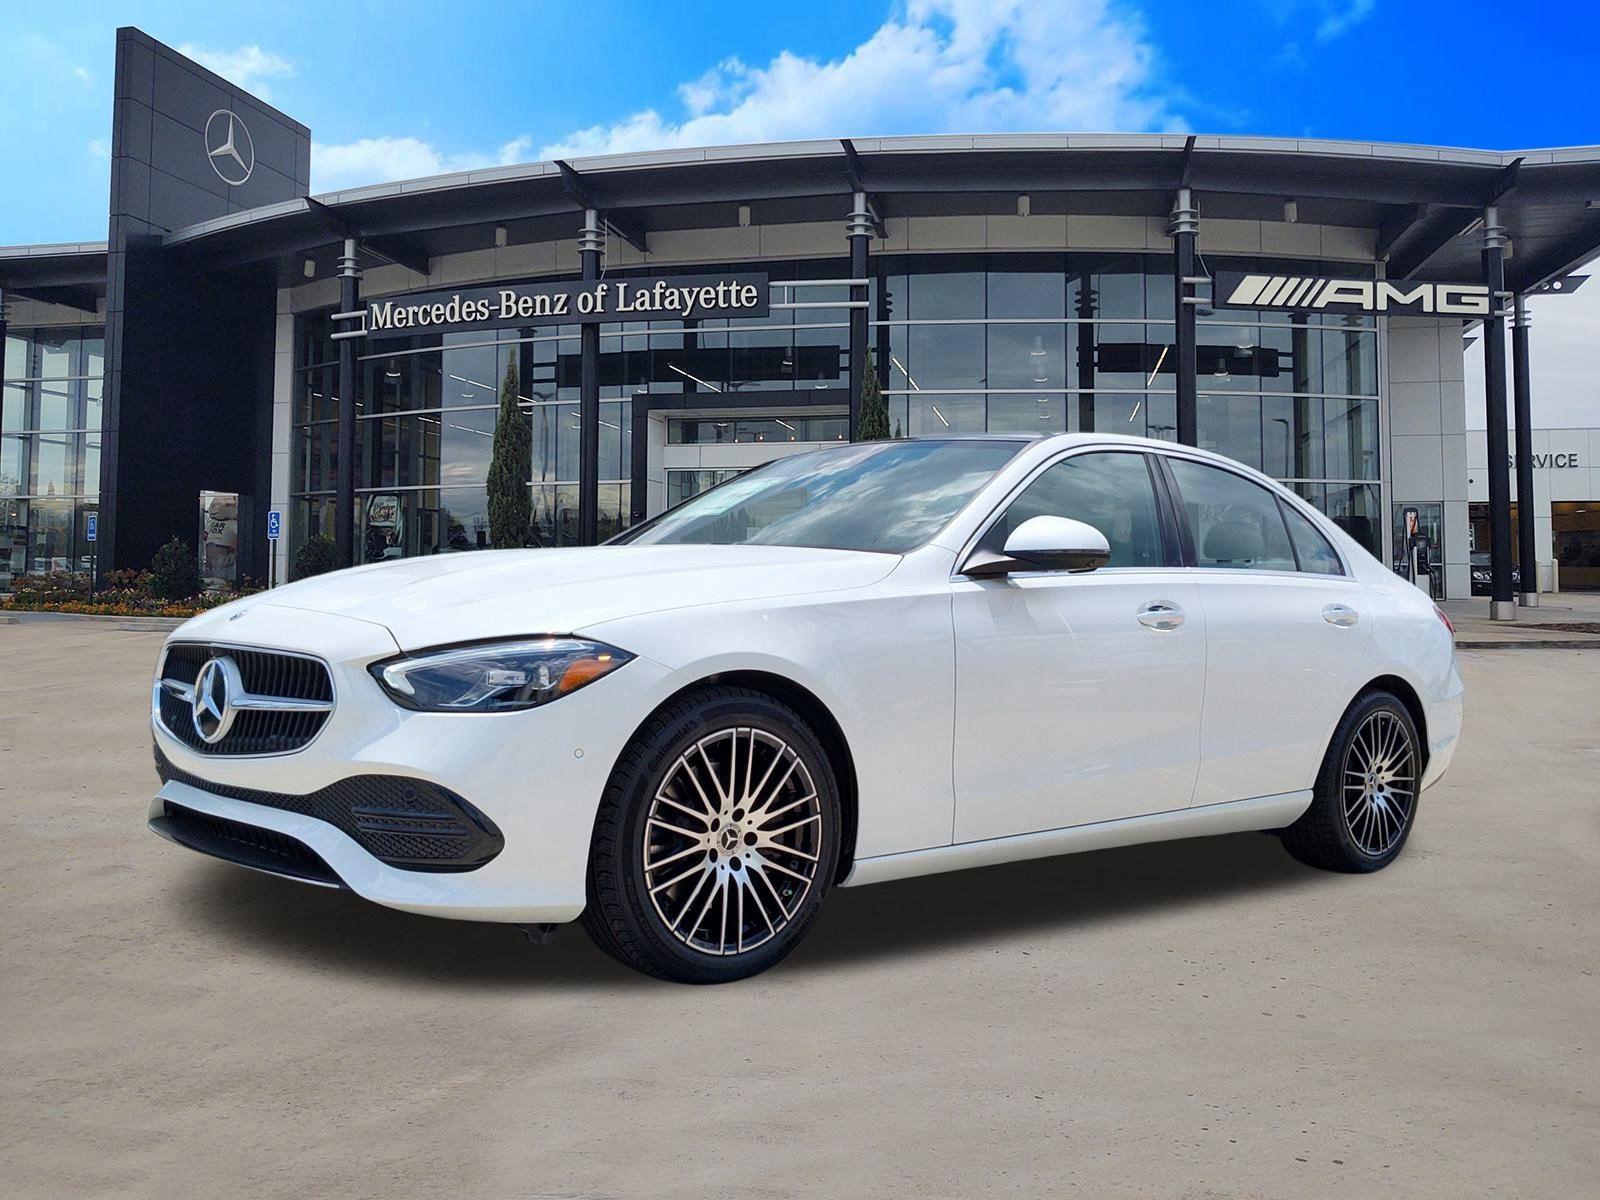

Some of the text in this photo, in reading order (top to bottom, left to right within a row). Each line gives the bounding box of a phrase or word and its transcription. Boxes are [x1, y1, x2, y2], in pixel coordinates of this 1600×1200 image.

[370, 280, 758, 331] Mercedes-Benz of Lafayette
[1508, 453, 1579, 468] SRVICE
